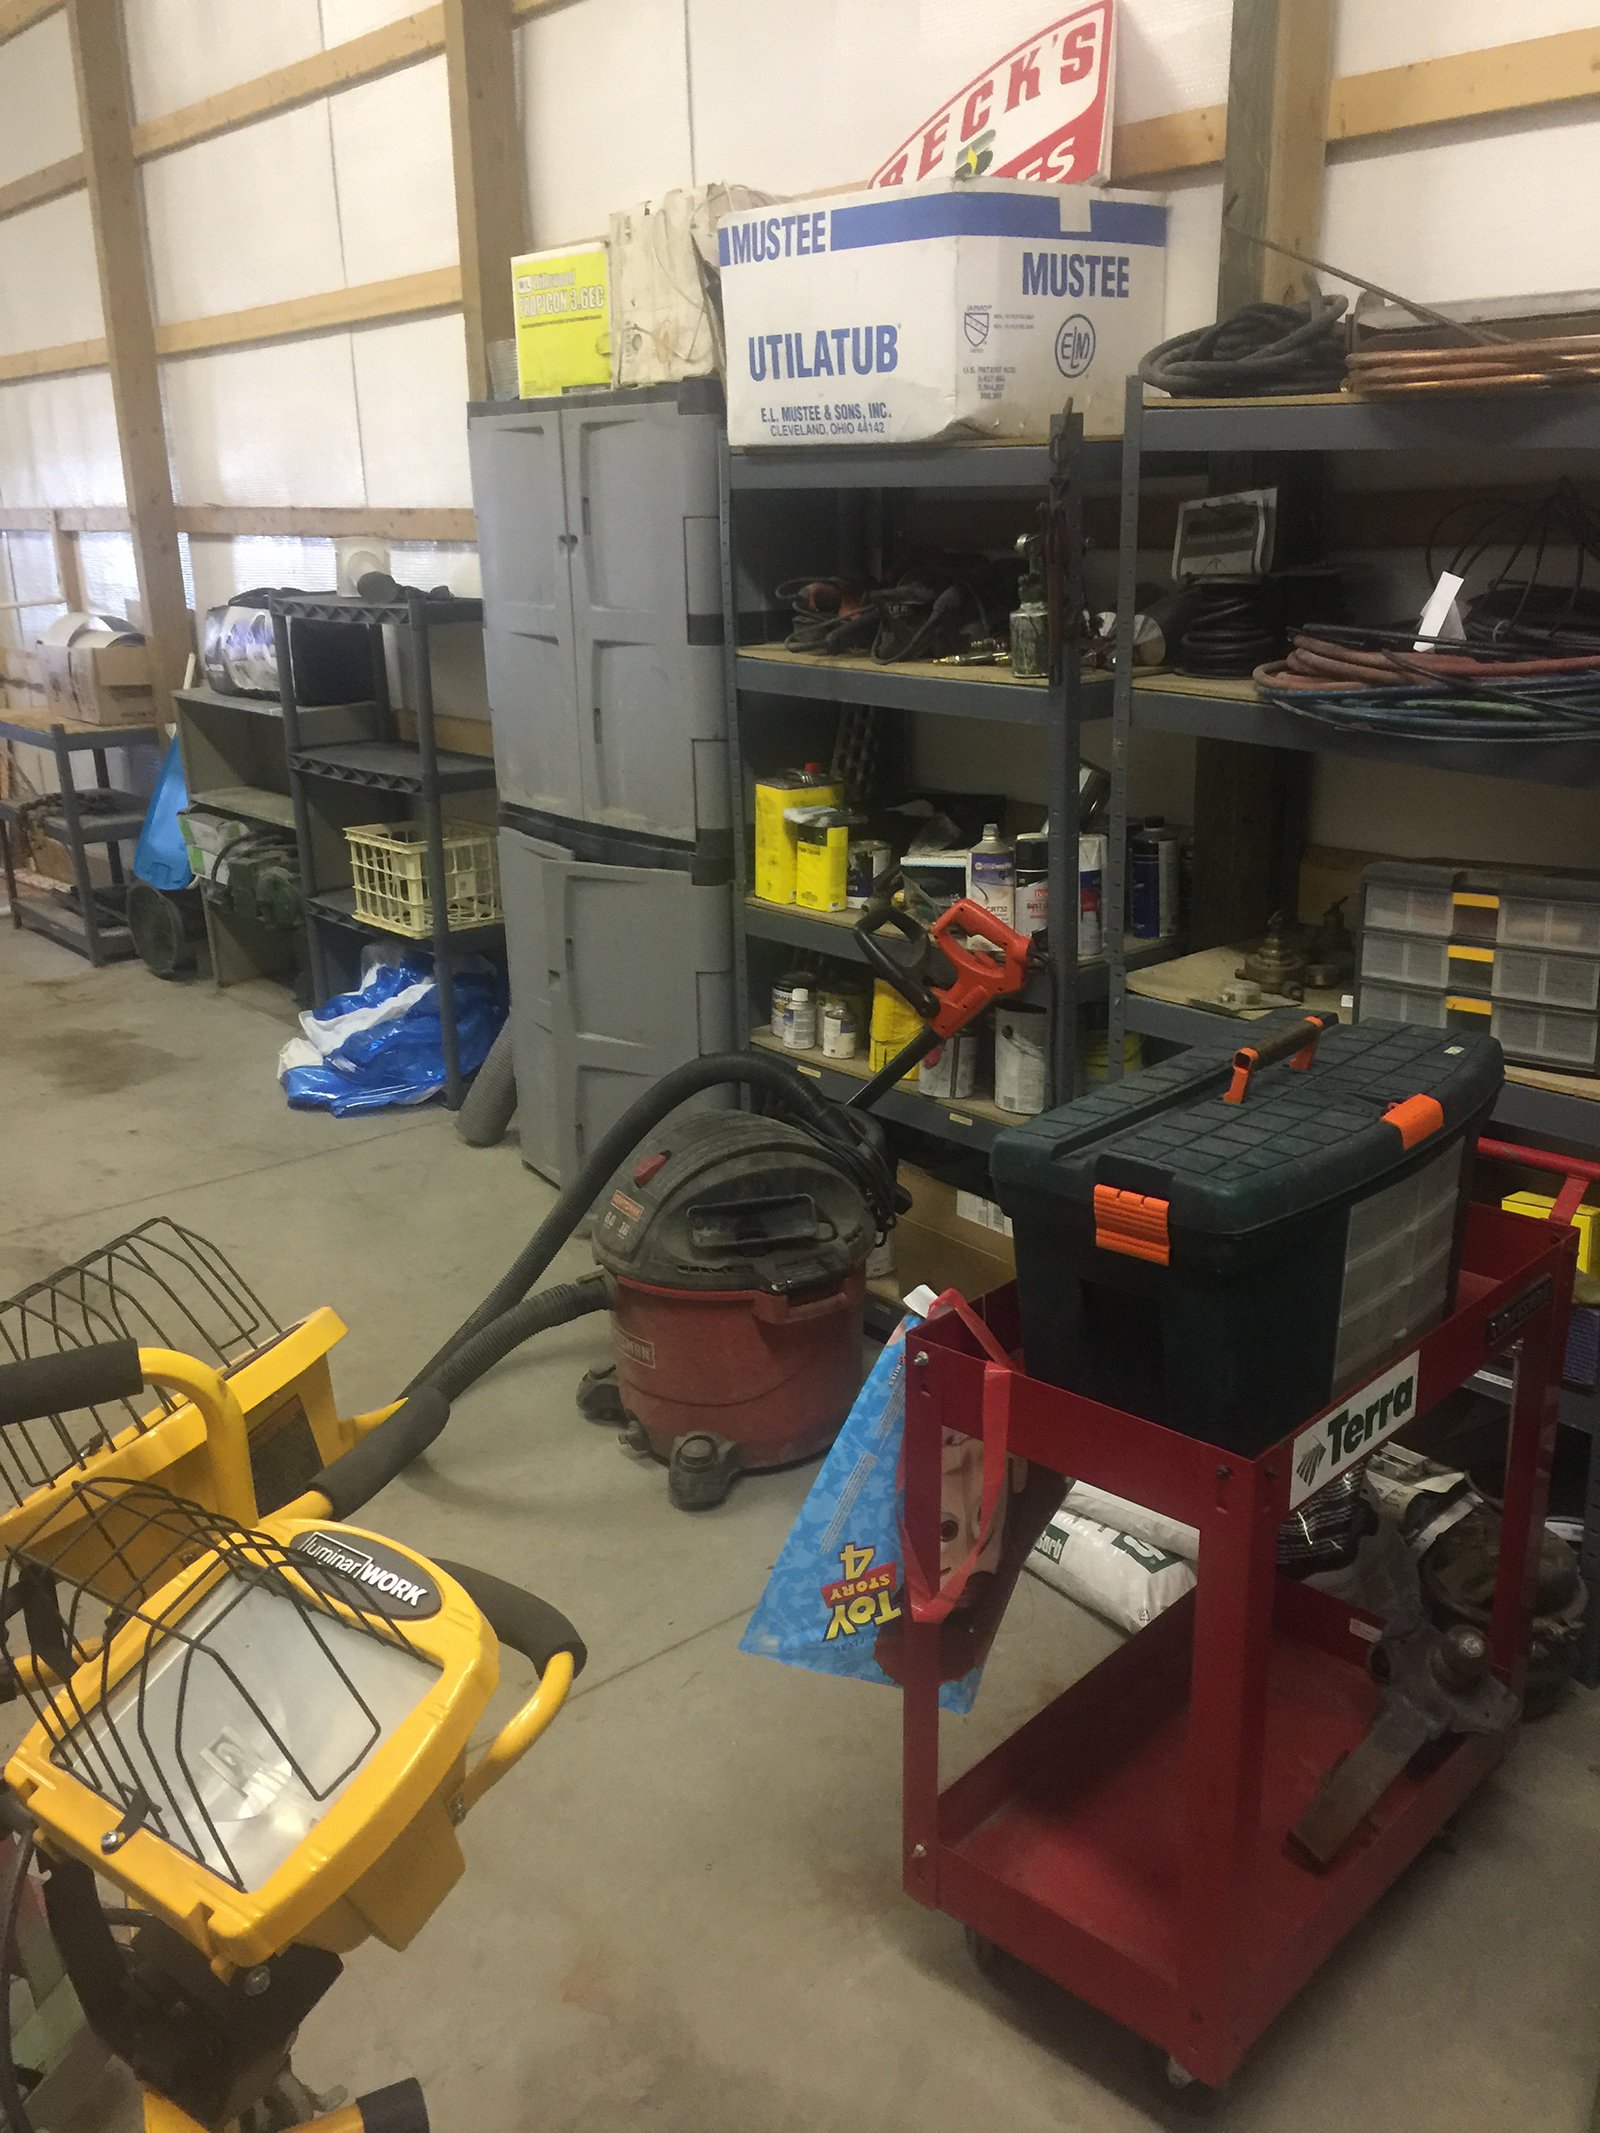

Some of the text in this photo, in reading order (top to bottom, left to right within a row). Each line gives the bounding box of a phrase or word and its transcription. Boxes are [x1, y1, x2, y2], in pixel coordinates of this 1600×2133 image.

[732, 211, 826, 264] MUSTEE
[1022, 252, 1129, 298] MUSTEE
[570, 285, 605, 312] 3.6EC
[748, 324, 899, 383] UTILATUB
[761, 402, 892, 422] E.L. MUSTEE & SONS, INC.
[770, 422, 885, 437] CLEVELAND, OHIO 44142
[1327, 1374, 1414, 1466] Terra
[840, 1544, 875, 1581] 4
[829, 1573, 891, 1601] STORY
[825, 1590, 902, 1640] TOY
